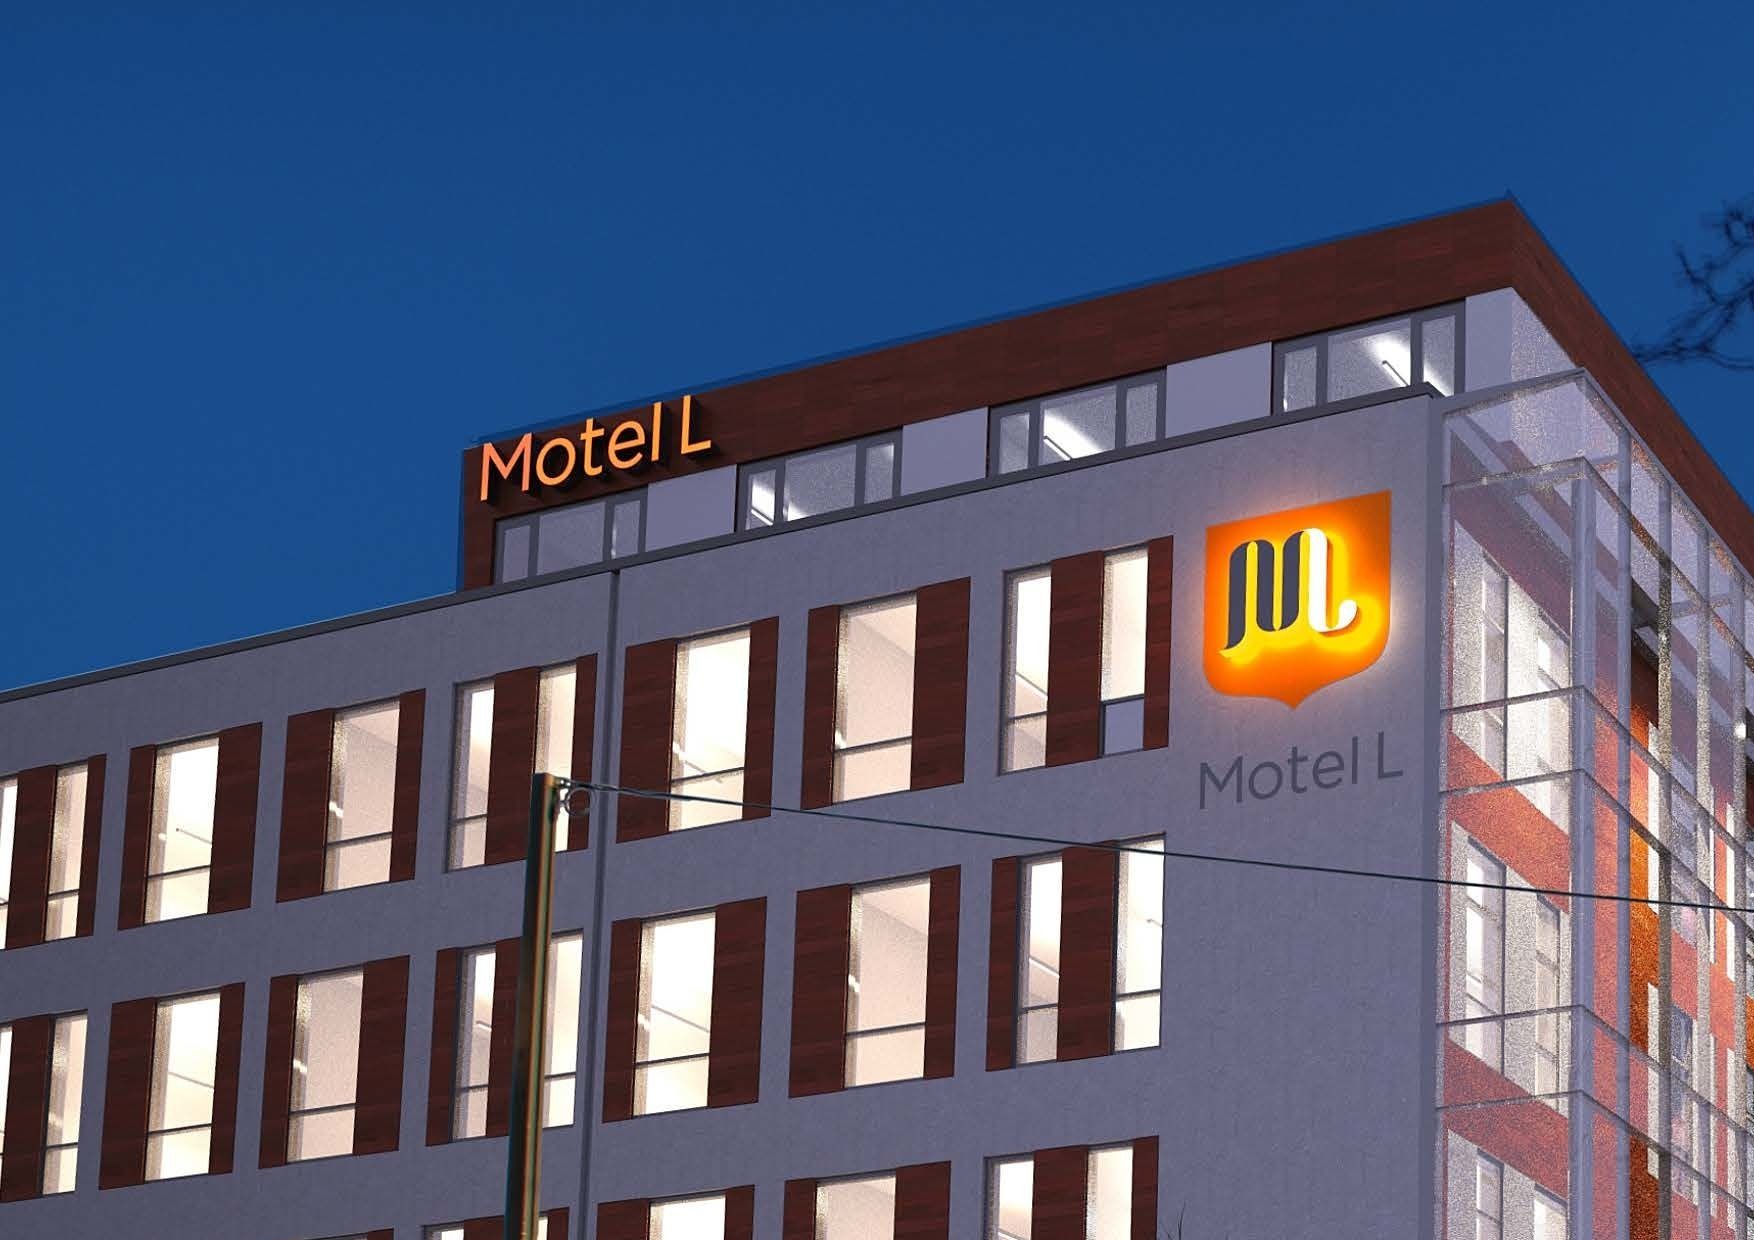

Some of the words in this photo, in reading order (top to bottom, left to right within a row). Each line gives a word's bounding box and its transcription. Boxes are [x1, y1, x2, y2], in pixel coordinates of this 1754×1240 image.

[480, 401, 662, 502] Motel
[680, 394, 713, 456] L
[1198, 735, 1359, 811] Motel
[1376, 730, 1404, 781] L
